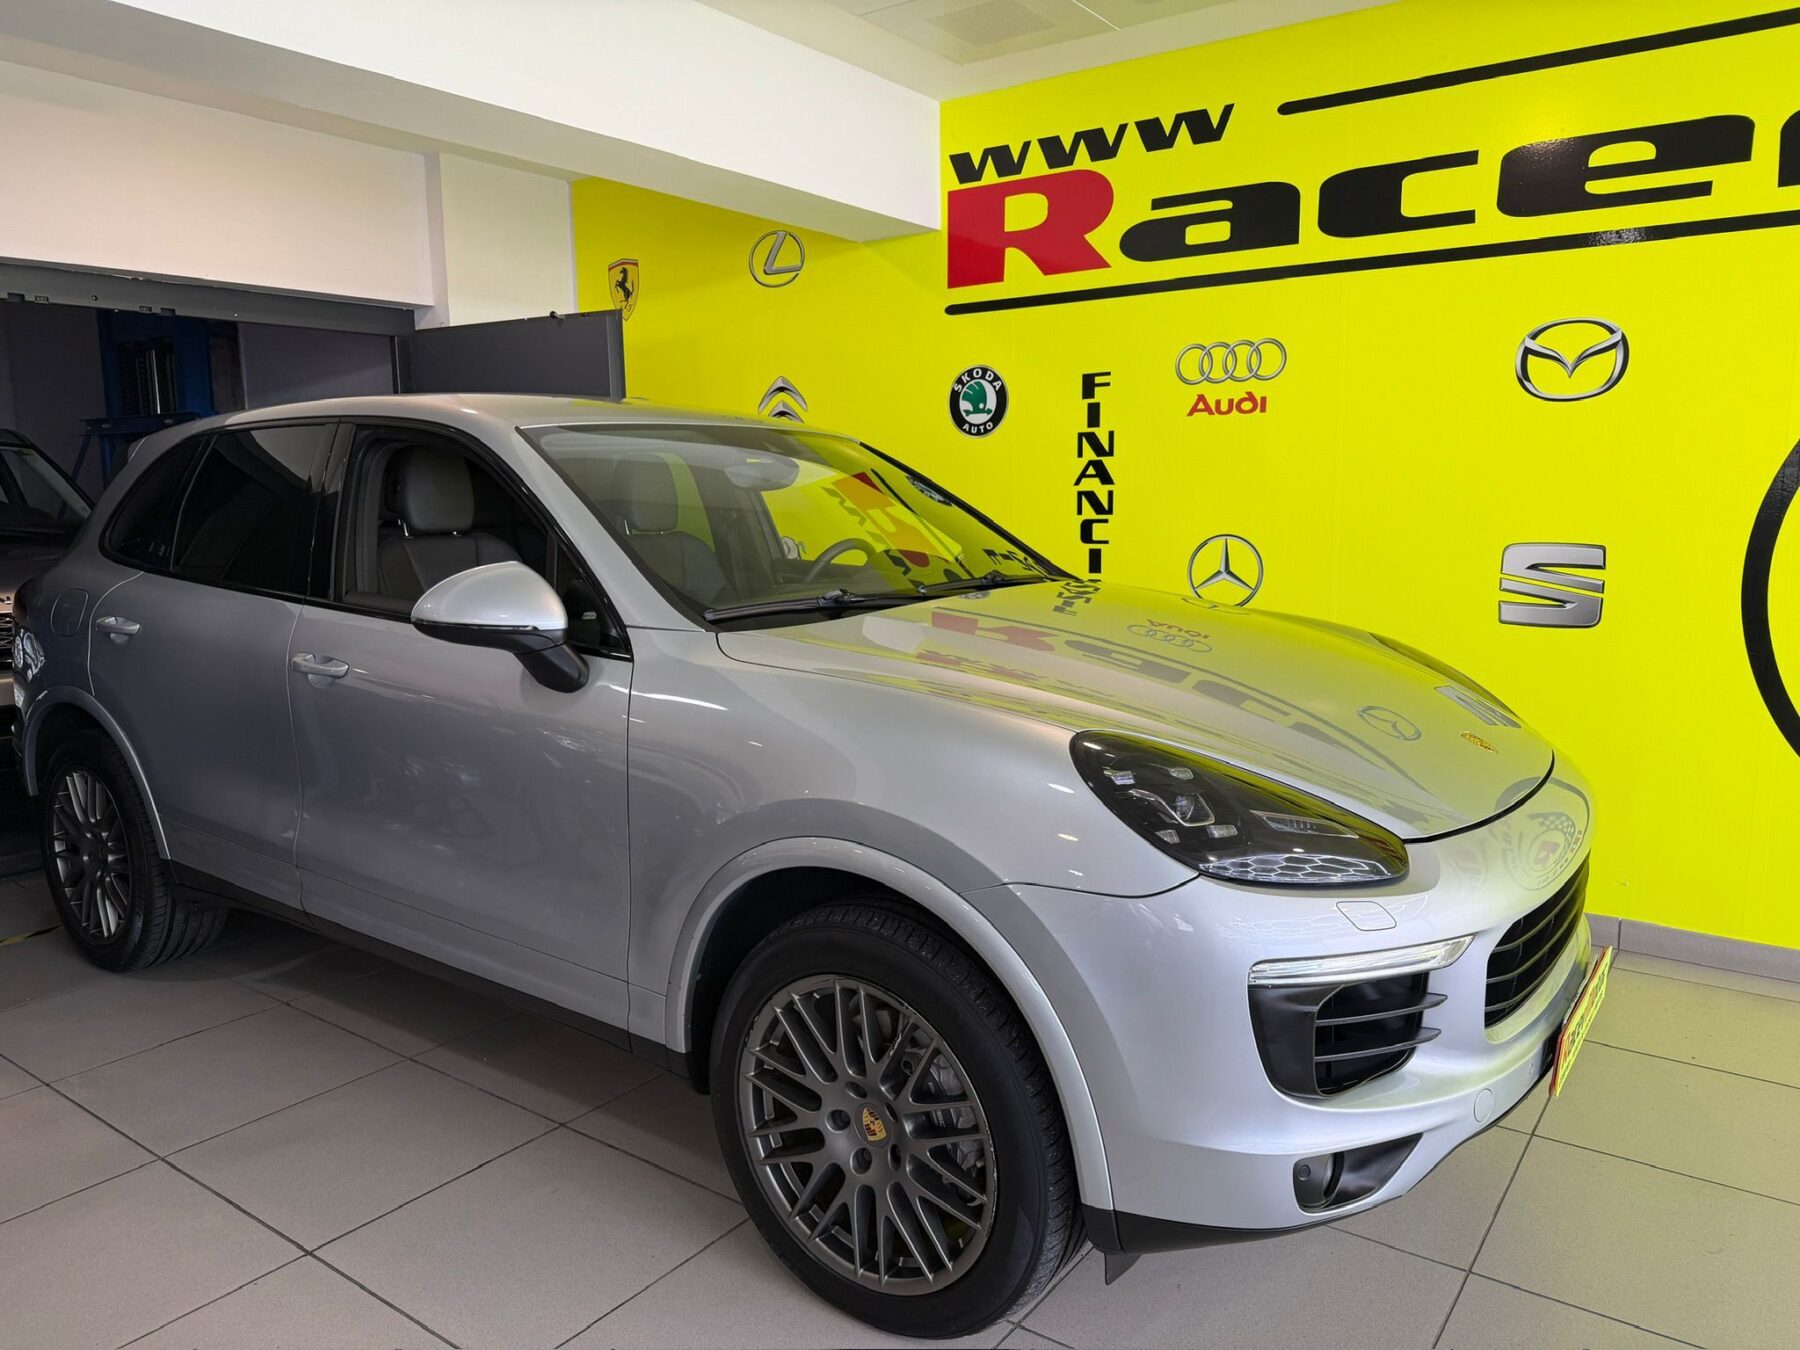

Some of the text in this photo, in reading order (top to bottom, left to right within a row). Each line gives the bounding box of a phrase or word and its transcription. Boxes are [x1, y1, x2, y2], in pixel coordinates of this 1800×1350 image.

[948, 109, 1800, 290] Race
[963, 421, 994, 434] AUTO
[1187, 391, 1268, 416] Audi
[1074, 371, 1115, 584] FINANCI
